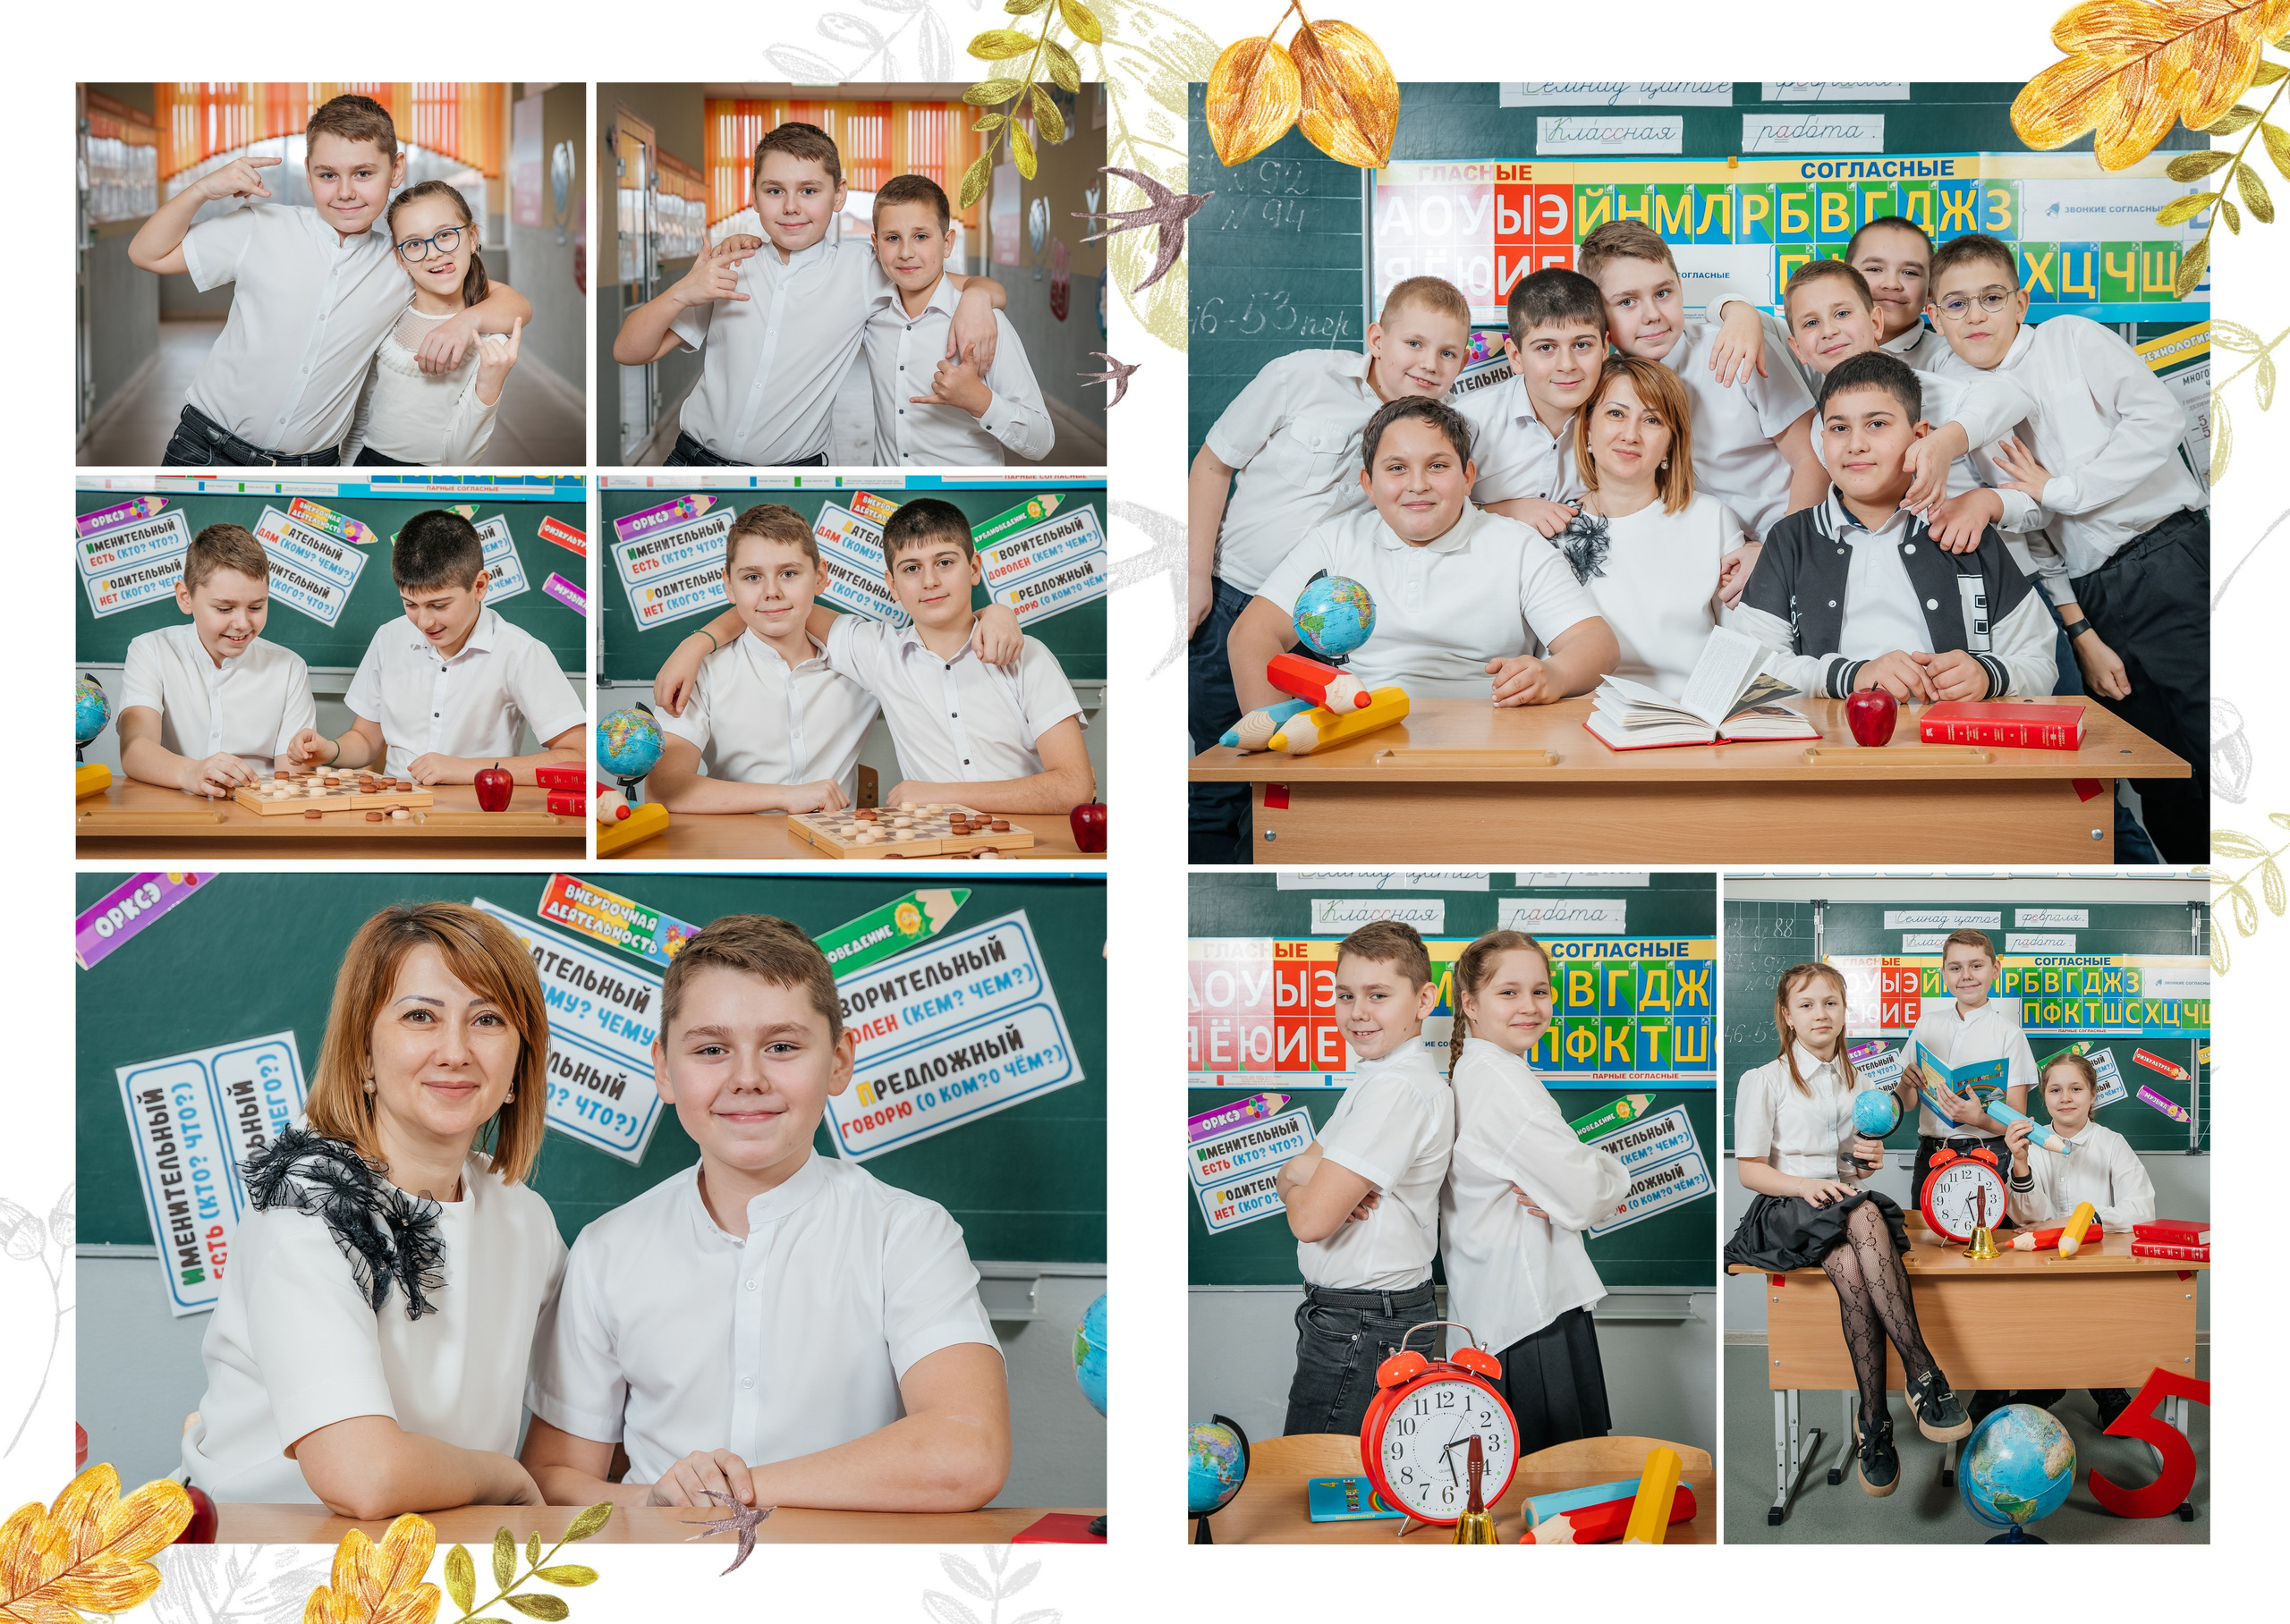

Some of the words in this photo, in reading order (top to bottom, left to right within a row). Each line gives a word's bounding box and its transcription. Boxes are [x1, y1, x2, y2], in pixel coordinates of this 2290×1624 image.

[1419, 165, 1532, 182] ГЛАСНЫЕ
[1801, 160, 1955, 179] СОГЛАСНЫЕ
[2065, 206, 2107, 214] ЗВОНКИЕ
[91, 510, 125, 529] ОРКСЭ
[291, 509, 341, 533] ДЕЯТЕЛЬНОСТЬ
[299, 502, 341, 523] ВНЕУРОЧНАЯ
[632, 511, 669, 531] ОРКСЭ
[86, 519, 175, 554] ИМЕНИТЕЛЬНЫЙ
[258, 528, 279, 544] ДАМ
[544, 524, 586, 550] ФИЗКУЛЬТУ
[817, 526, 841, 544] ДАМ
[974, 512, 1027, 543] КУБАНОВЕДЕНИЕ
[281, 524, 343, 561] ДАТЕЛЬНЫЙ
[627, 519, 725, 561] ИМЕНИТЕЛЬНЫЙ
[990, 517, 1084, 563] ТВОРИТЕЛЬНЫЙ
[90, 551, 114, 567] ЕСТЬ
[632, 557, 659, 574] ЕСТЬ
[988, 557, 1031, 580] ДОВОЛЕН
[102, 558, 182, 592] РОДИТЕЛЬНЫЙ
[268, 561, 330, 599] НИТЕЛЬНЫЙ
[646, 565, 726, 602] РОДИТЕЛЬНЫ
[1010, 561, 1093, 605] ПРЕДЛОЖНЫЙ
[99, 593, 118, 606] НЕТ
[643, 603, 664, 617] НЕТ
[94, 881, 162, 938] ОРКСЭ
[564, 884, 658, 932] ВНЕУРОЧНАЯ
[547, 901, 658, 955] ДЕЯТЕЛЬНОСТЬ
[826, 923, 895, 965] ОВЕДЕНИЕ
[1551, 943, 1689, 958] СОГЛАСНЫЕ
[2034, 957, 2111, 966] СОГЛАСНЫЕ
[531, 945, 651, 1014] АТЕЛЬНЫЙ
[856, 1023, 1024, 1108] ПРЕДЛОЖНЫЙ
[841, 1100, 913, 1139] ГОВОРЮ
[1202, 1109, 1241, 1131] ОРКСЭ
[1197, 1117, 1299, 1162] ИМЕНИТЕЛЬНЫЙ
[1202, 1159, 1231, 1176] ЕСТЬ
[1961, 1170, 1972, 1179] 12
[136, 1087, 206, 1286] ИМЕНИТЕЛЬНЫЙ
[1940, 1183, 1950, 1193] 10
[1937, 1197, 1944, 1205] 9
[1990, 1194, 1997, 1204] 3
[1214, 1205, 1234, 1221] НЕТ
[1413, 1399, 1429, 1416] 11
[1435, 1391, 1455, 1408] 12
[1465, 1395, 1472, 1411] 1
[1396, 1417, 1415, 1436] 10
[1480, 1411, 1492, 1427] 2
[1391, 1442, 1404, 1460] 9
[1488, 1434, 1500, 1451] 3
[2088, 1366, 2210, 1518] 5
[1401, 1467, 1413, 1484] 8
[1419, 1483, 1430, 1501] 7
[1442, 1486, 1455, 1504] 6
